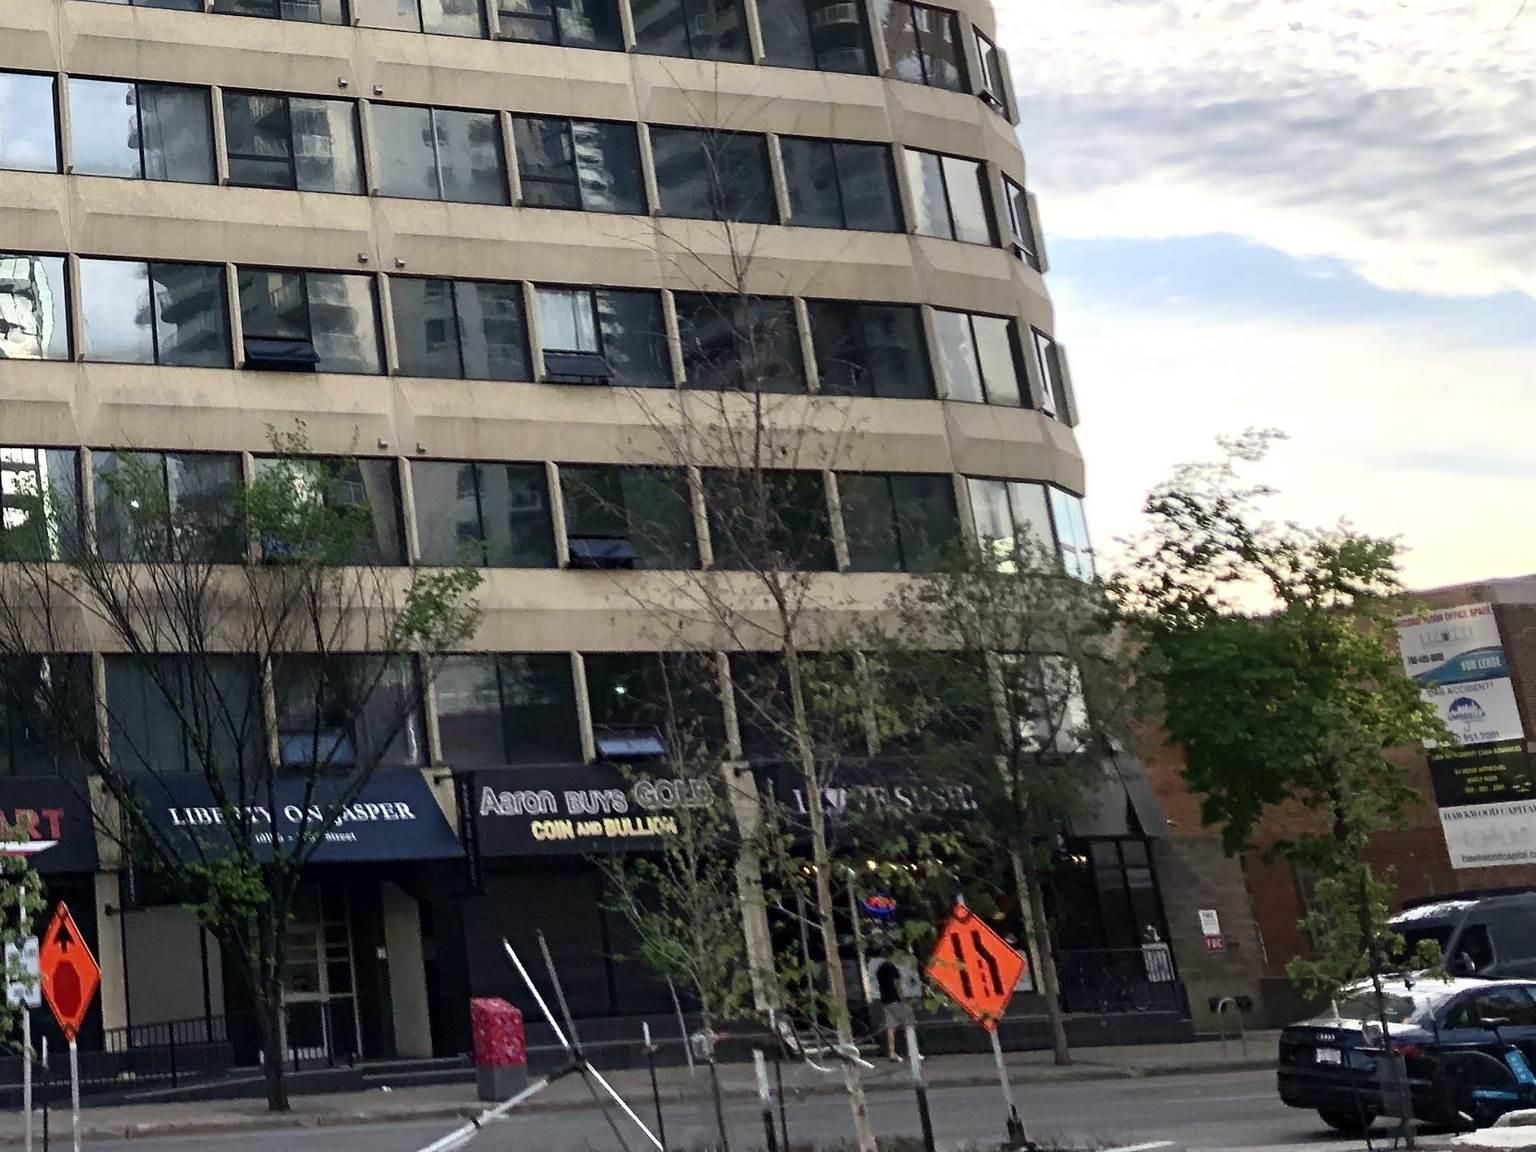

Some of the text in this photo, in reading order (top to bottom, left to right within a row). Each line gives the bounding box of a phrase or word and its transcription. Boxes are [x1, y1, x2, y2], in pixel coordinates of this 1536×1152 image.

[479, 778, 714, 815] Aaron BUYS GOLD
[283, 804, 323, 824] ON
[530, 816, 678, 841] COIN AND BULLION
